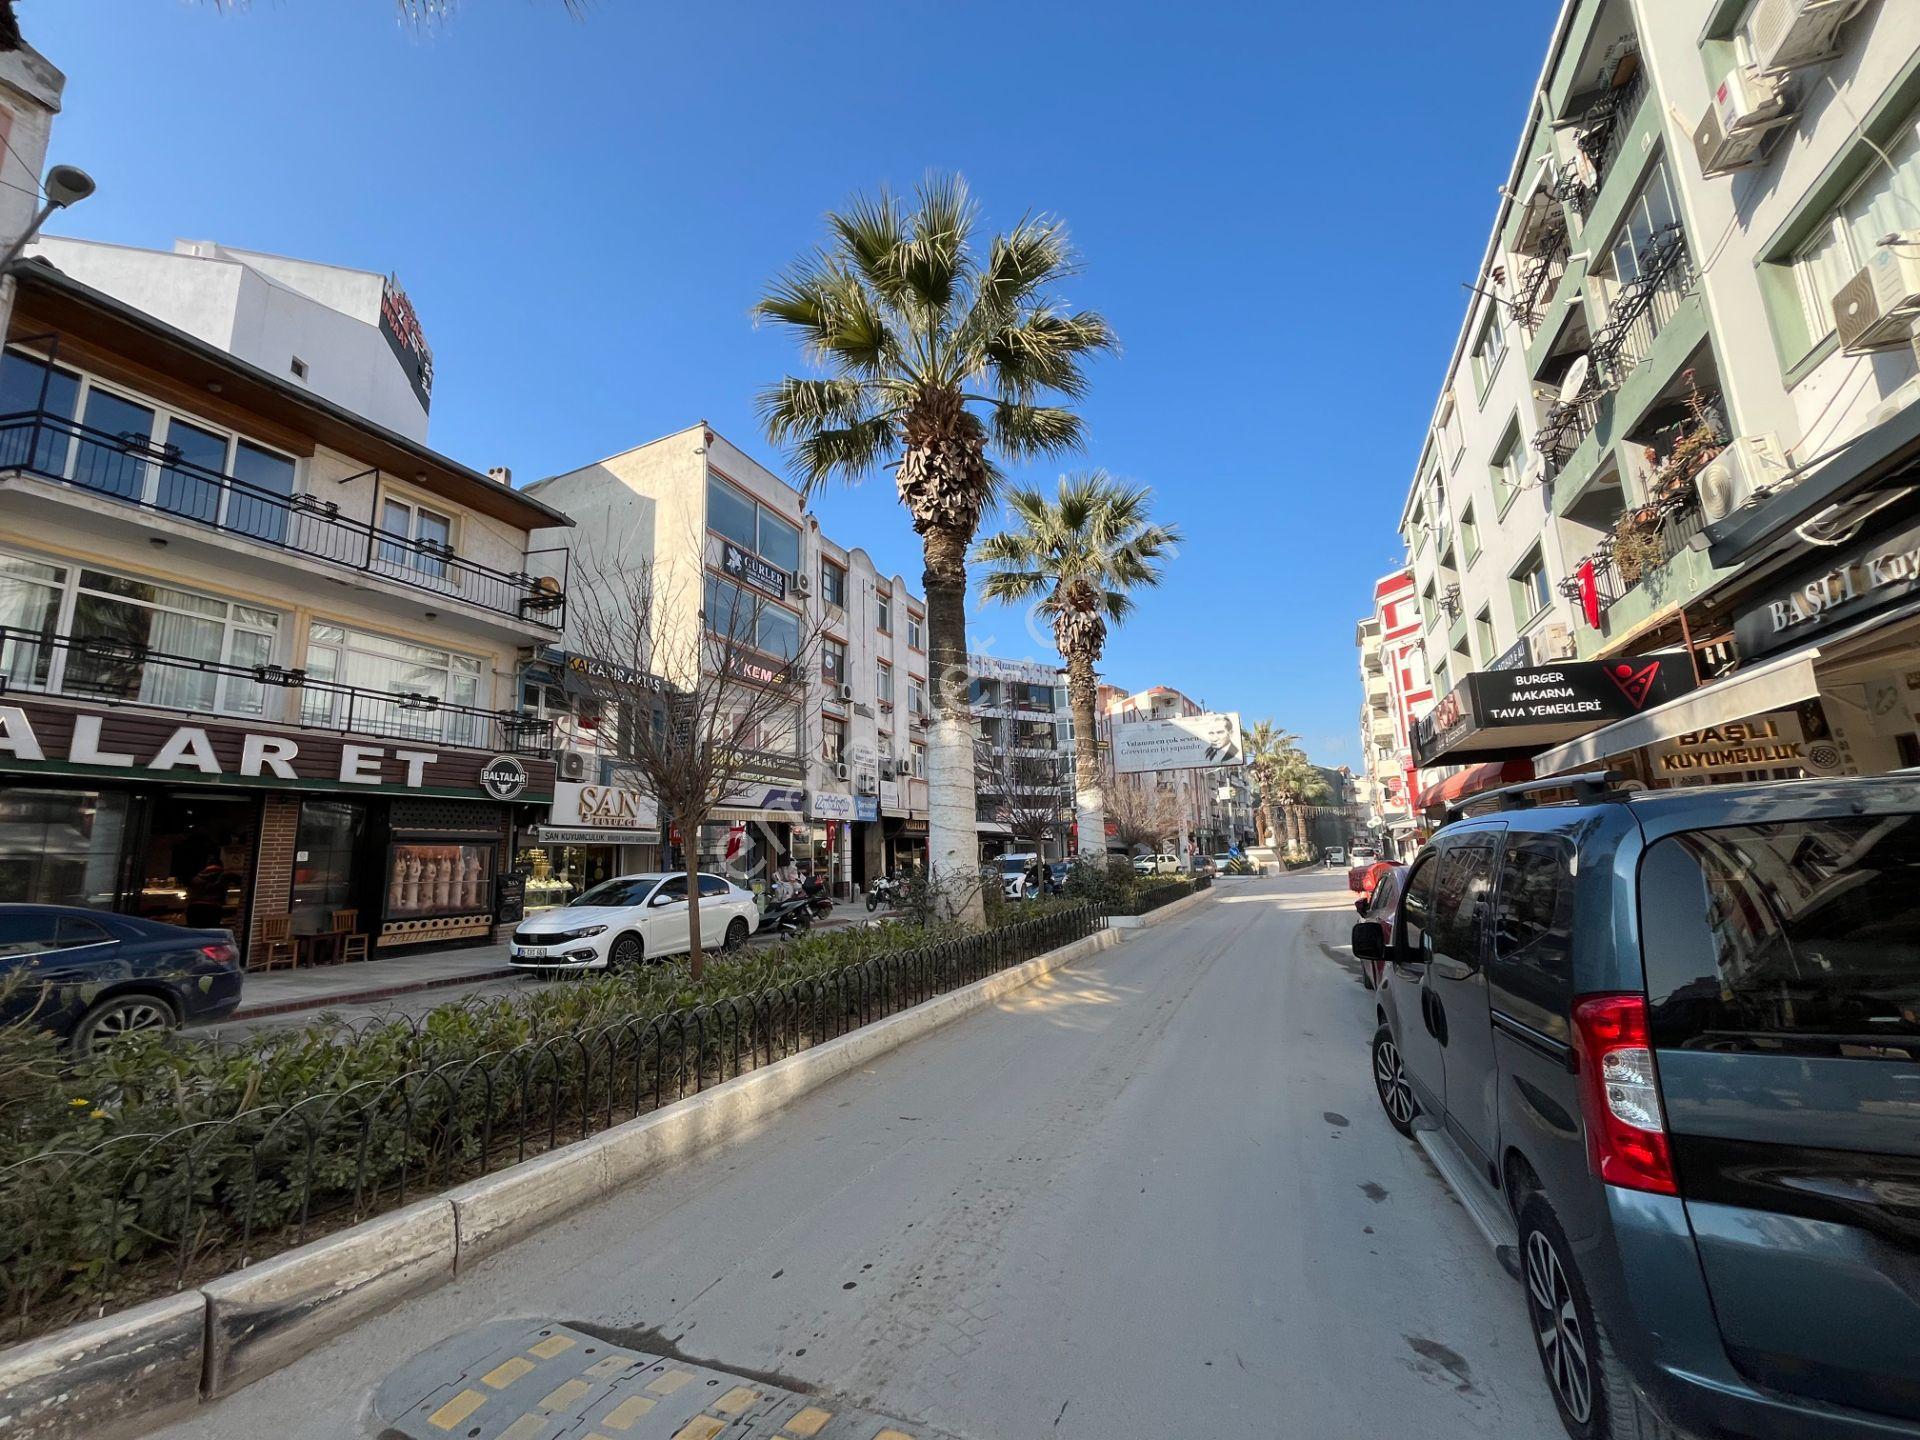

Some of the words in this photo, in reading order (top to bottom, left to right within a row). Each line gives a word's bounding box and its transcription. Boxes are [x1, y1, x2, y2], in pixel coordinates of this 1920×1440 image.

[1769, 566, 1857, 633] BAŞLI
[1515, 672, 1565, 685] BURGER
[1511, 688, 1575, 702] MAKARNA
[1490, 707, 1526, 719] TAVA
[1529, 699, 1602, 716] YEMEKLERİ
[1679, 721, 1779, 746] BAŞLI
[339, 744, 438, 788] ET
[483, 771, 526, 783] BALTALAR
[579, 786, 641, 822] ŞAN
